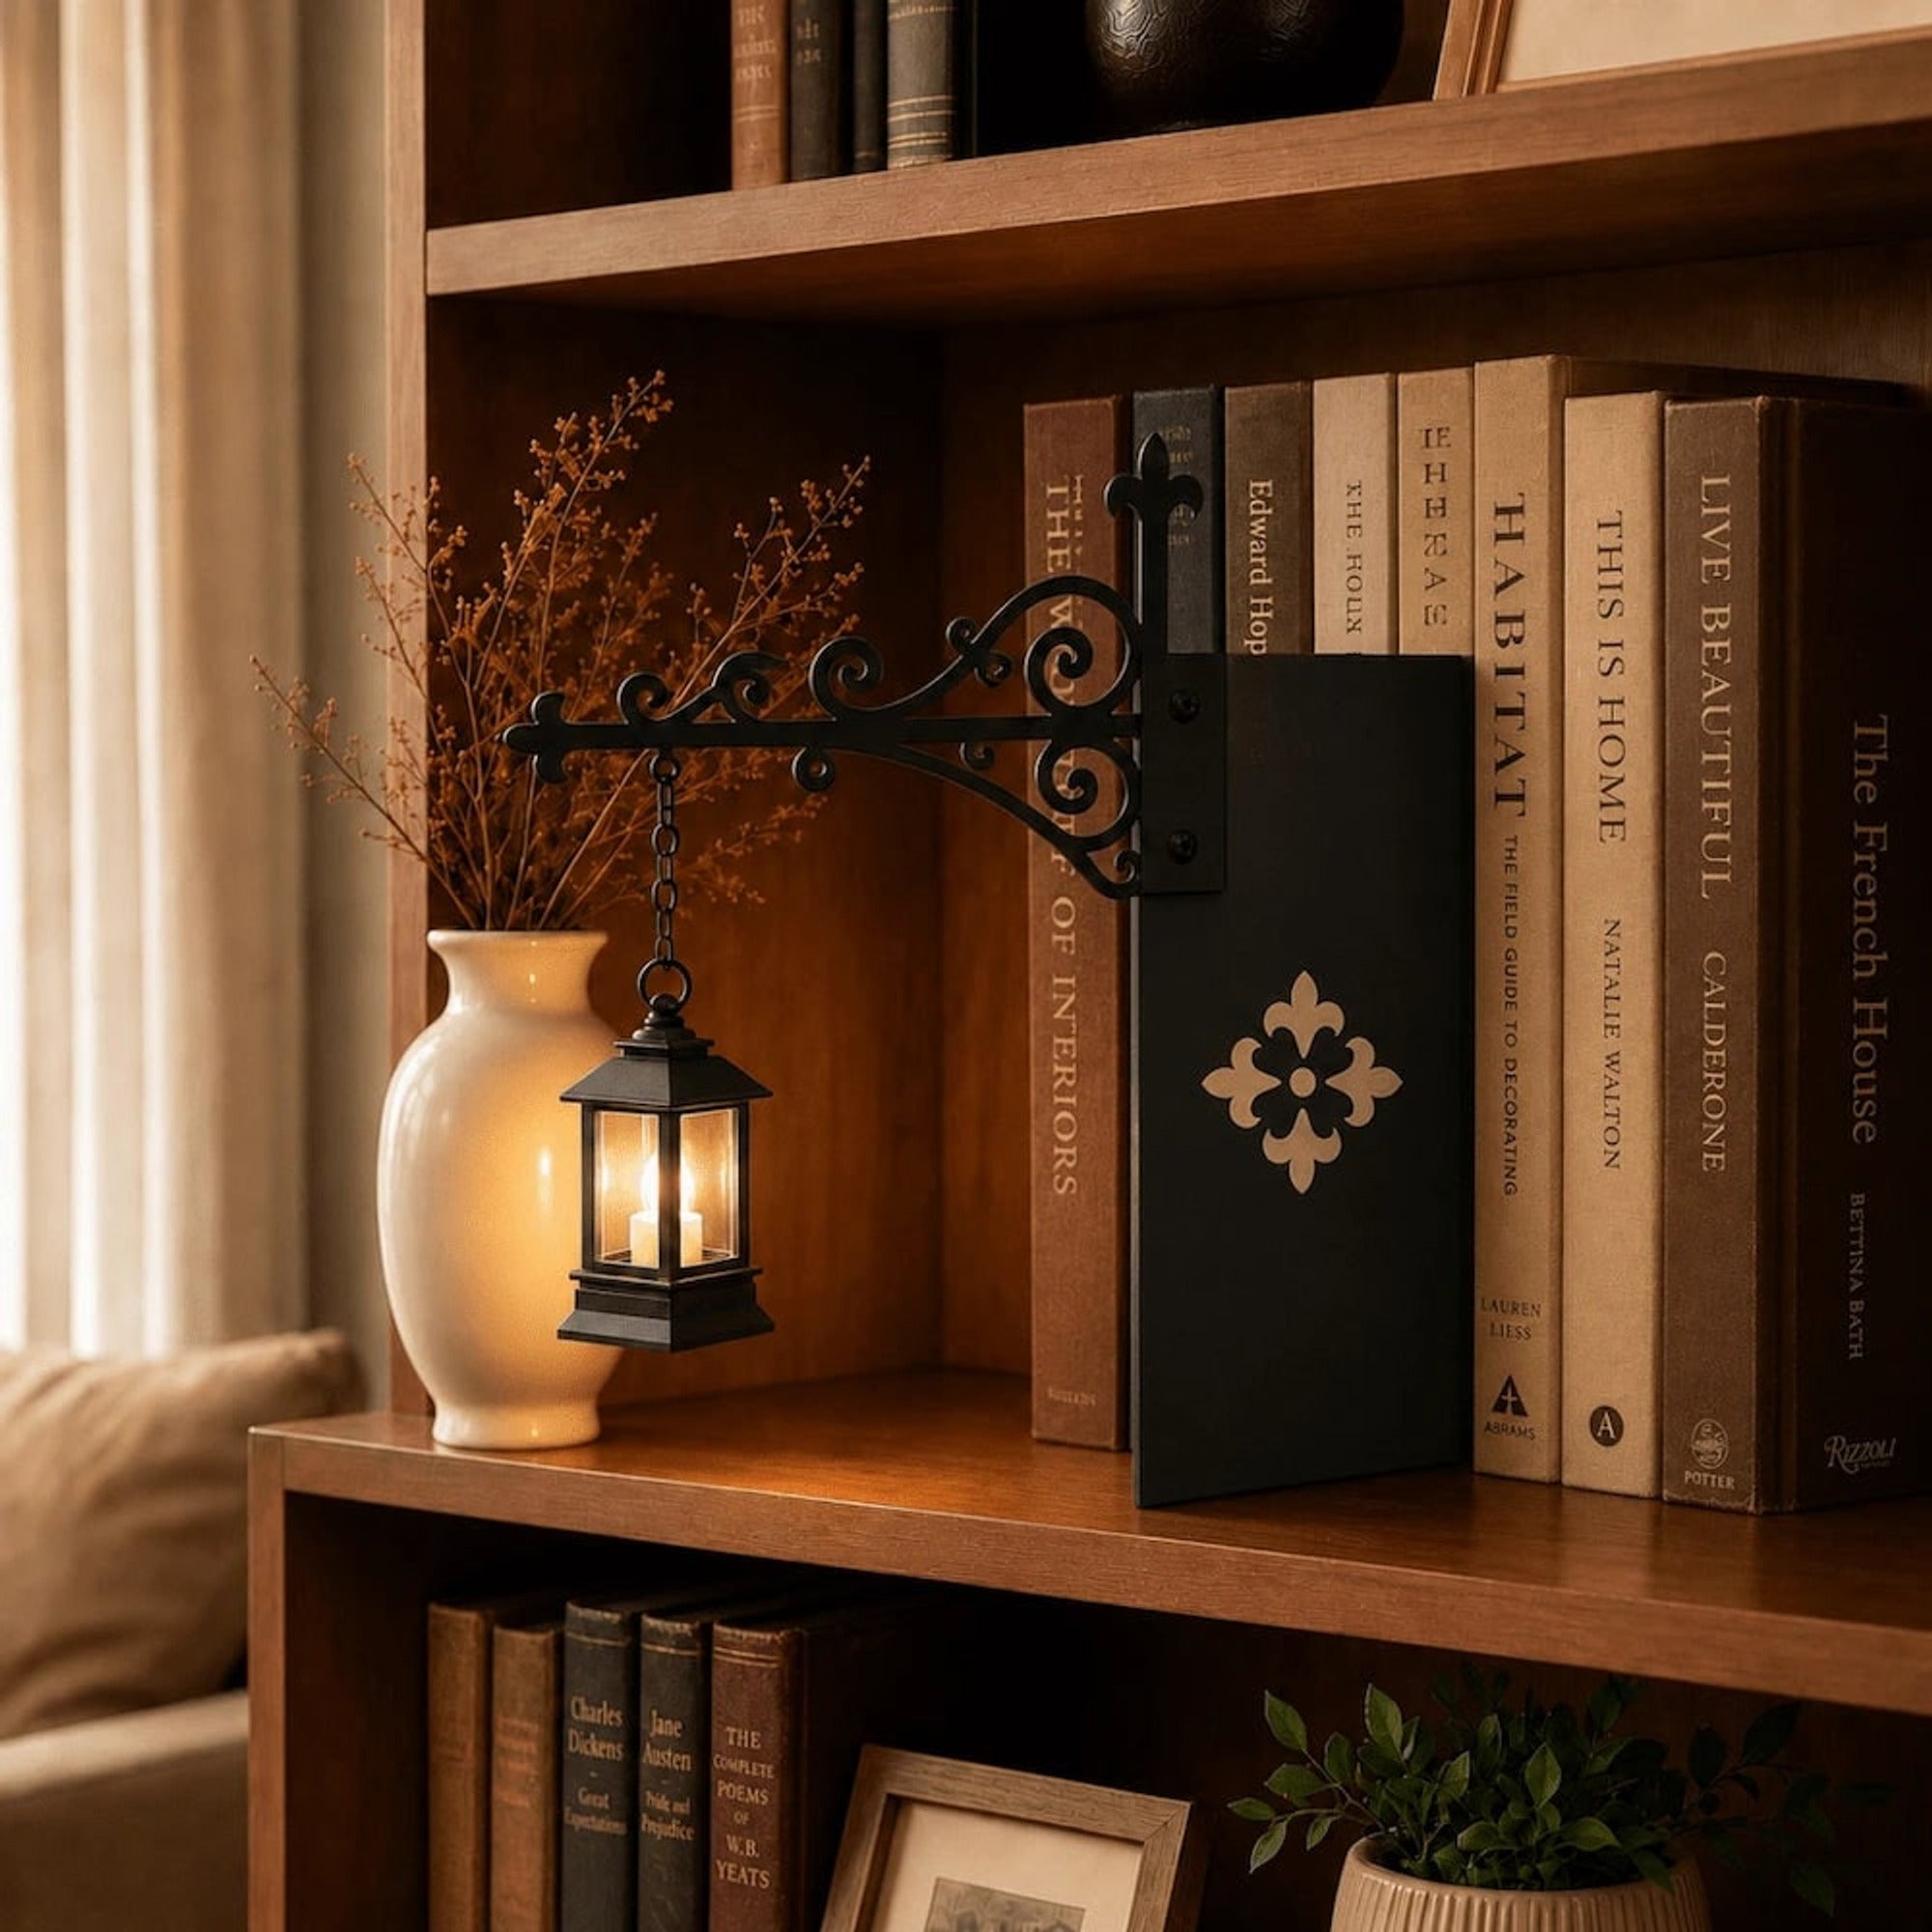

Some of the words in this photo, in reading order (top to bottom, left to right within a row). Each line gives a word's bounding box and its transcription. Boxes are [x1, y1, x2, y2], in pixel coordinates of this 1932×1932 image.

[1045, 474, 1073, 574] THE
[1249, 479, 1274, 585] Edward
[1700, 473, 1731, 584] LIVE
[1597, 511, 1626, 620] THIS
[1492, 493, 1526, 817] HABITAT
[1598, 639, 1626, 678] IS
[1598, 696, 1627, 844] HOME
[1700, 604, 1732, 899] BEAUTIFUL
[1852, 714, 1889, 804] The
[1504, 835, 1519, 874] THE
[1049, 895, 1076, 955] OF
[1503, 883, 1519, 939] FIELD
[1852, 819, 1889, 980] French
[1503, 948, 1520, 1011] GUIDE
[1604, 919, 1622, 1039] NATALIE
[1504, 1020, 1520, 1048] TO
[1701, 951, 1727, 1172] CALDERONE
[1050, 976, 1078, 1196] INTERIORS
[1852, 996, 1889, 1146] House
[1503, 1058, 1520, 1197] DECORATING
[1604, 1050, 1622, 1171] WALTON
[1848, 1192, 1866, 1293] BETTINA
[1480, 1297, 1542, 1319] LAUREN
[1489, 1322, 1532, 1341] LIESS
[1848, 1299, 1866, 1360] BATH
[1484, 1421, 1537, 1441] ABRAMS
[1684, 1469, 1736, 1491] POTTER
[570, 1695, 624, 1726] Charles
[649, 1708, 684, 1738] Jane
[725, 1725, 762, 1749] THE
[567, 1727, 625, 1762] Dickens
[641, 1741, 693, 1773] Austen
[712, 1753, 776, 1779] COMPLETE
[716, 1779, 770, 1805] POEMS
[732, 1810, 751, 1826] OF
[715, 1860, 772, 1890] YEATS
[725, 1833, 761, 1859] W.B.
